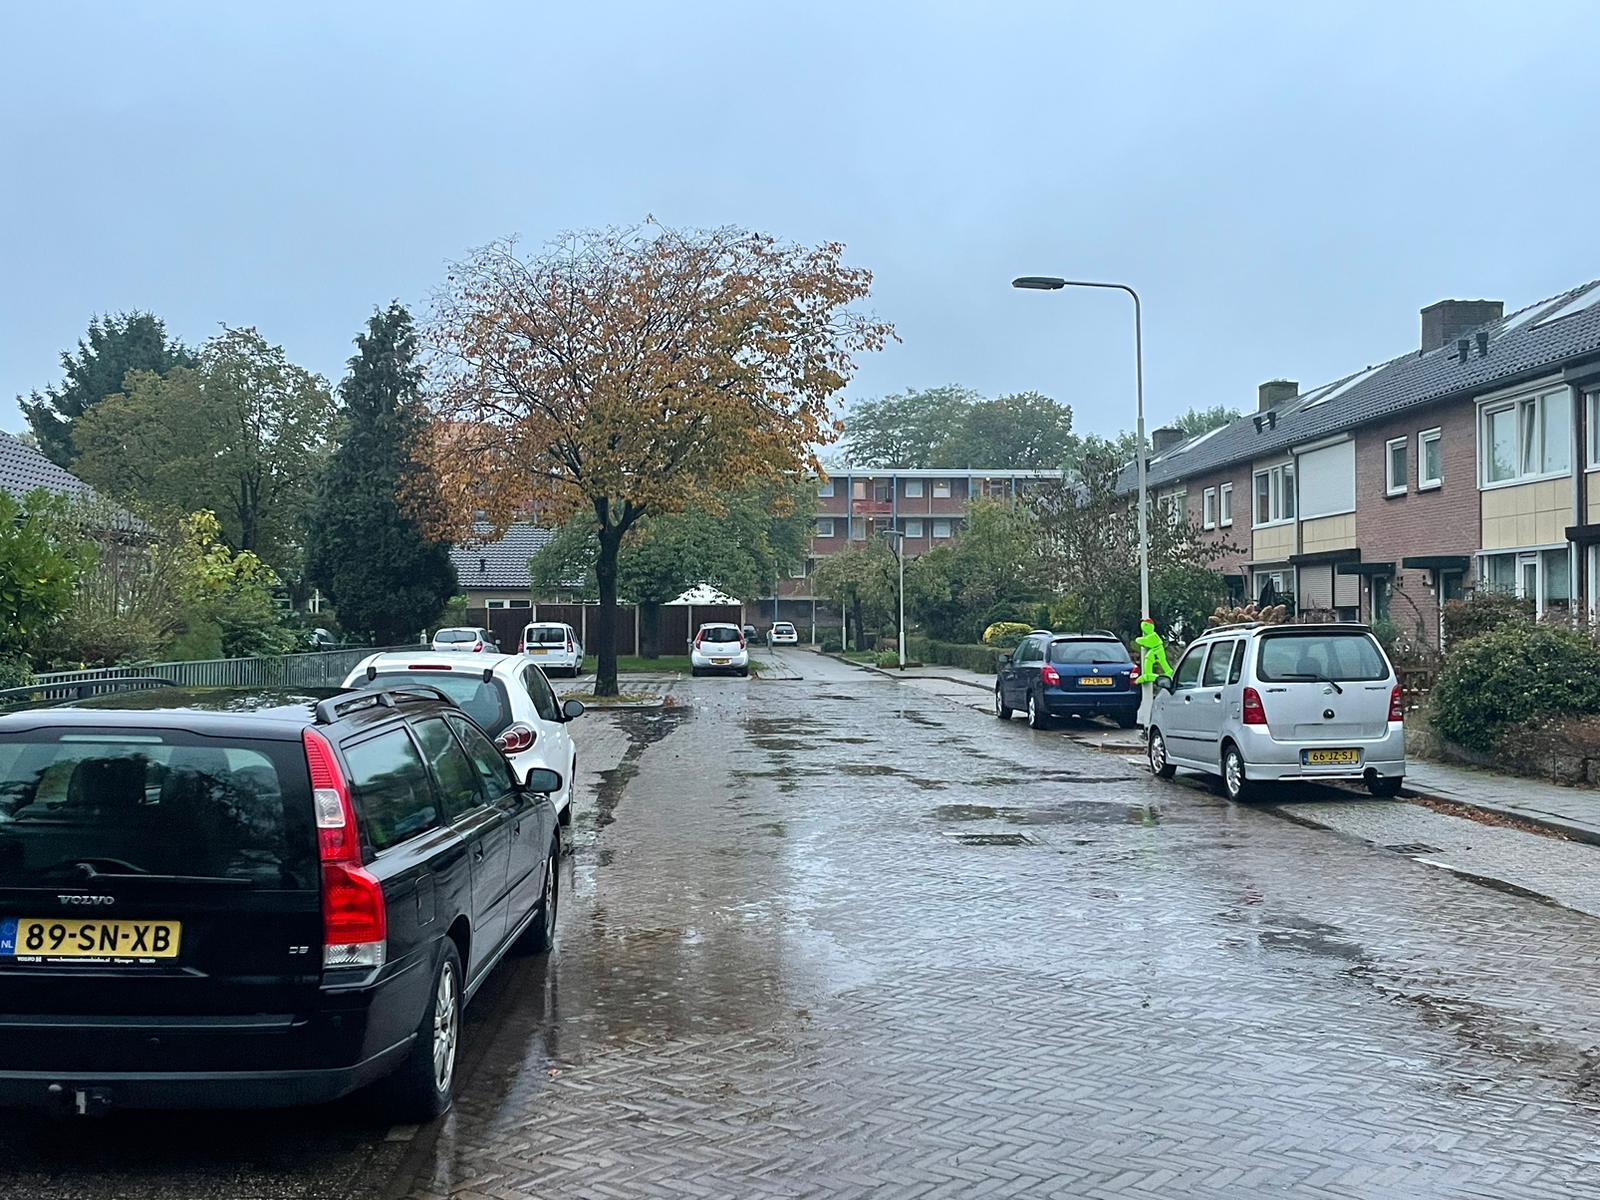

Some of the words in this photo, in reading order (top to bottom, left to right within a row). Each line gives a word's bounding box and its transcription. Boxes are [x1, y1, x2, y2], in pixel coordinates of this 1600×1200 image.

[57, 895, 115, 904] VOLVO
[26, 924, 170, 952] 89-SN-XB
[1, 940, 14, 948] NL
